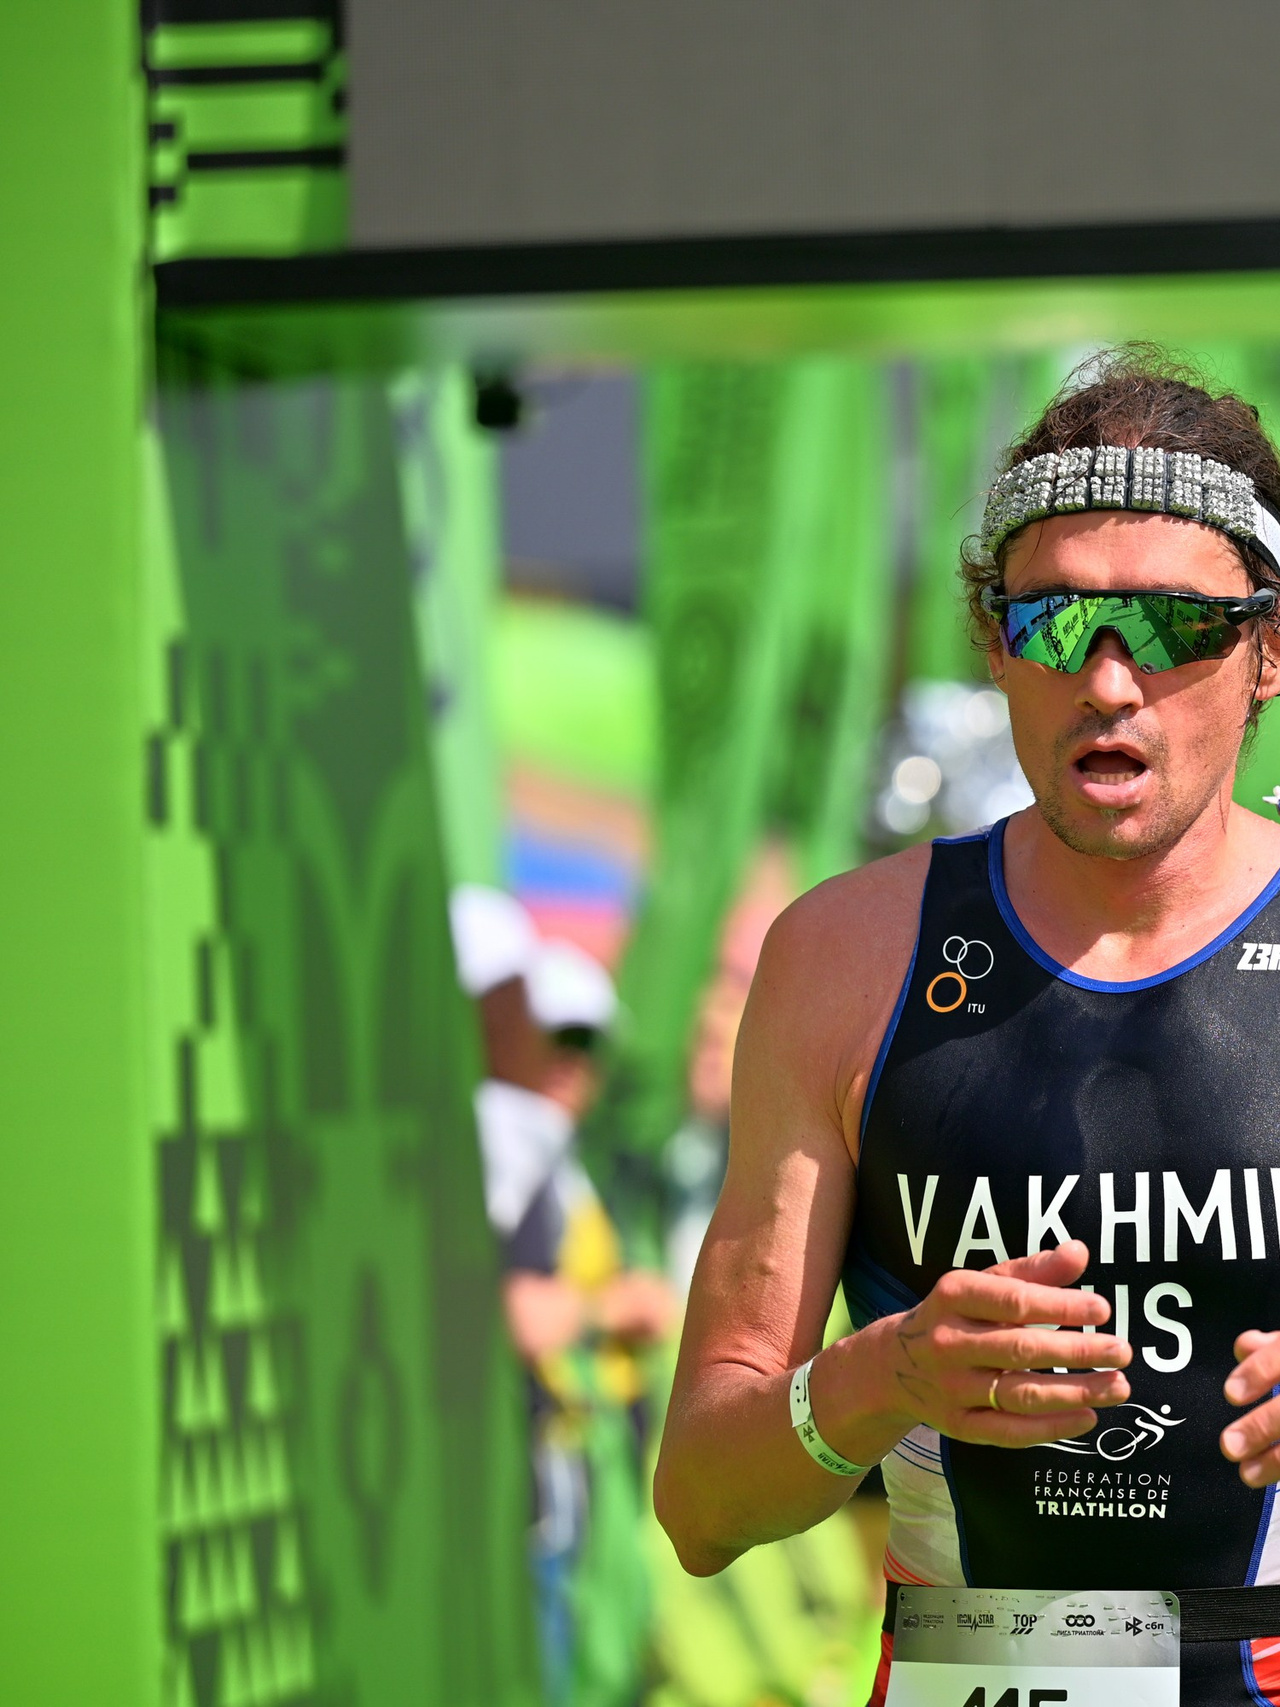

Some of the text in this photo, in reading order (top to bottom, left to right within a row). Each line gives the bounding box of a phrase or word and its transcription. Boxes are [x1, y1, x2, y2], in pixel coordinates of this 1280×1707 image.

[967, 1003, 986, 1014] ITU
[1034, 1469, 1171, 1486] FÉDÉRATION
[1034, 1486, 1169, 1500] FRANÇAISE DE
[1035, 1500, 1167, 1519] TRIATHLON
[978, 1614, 995, 1624] STAR
[1013, 1614, 1037, 1627] TOP
